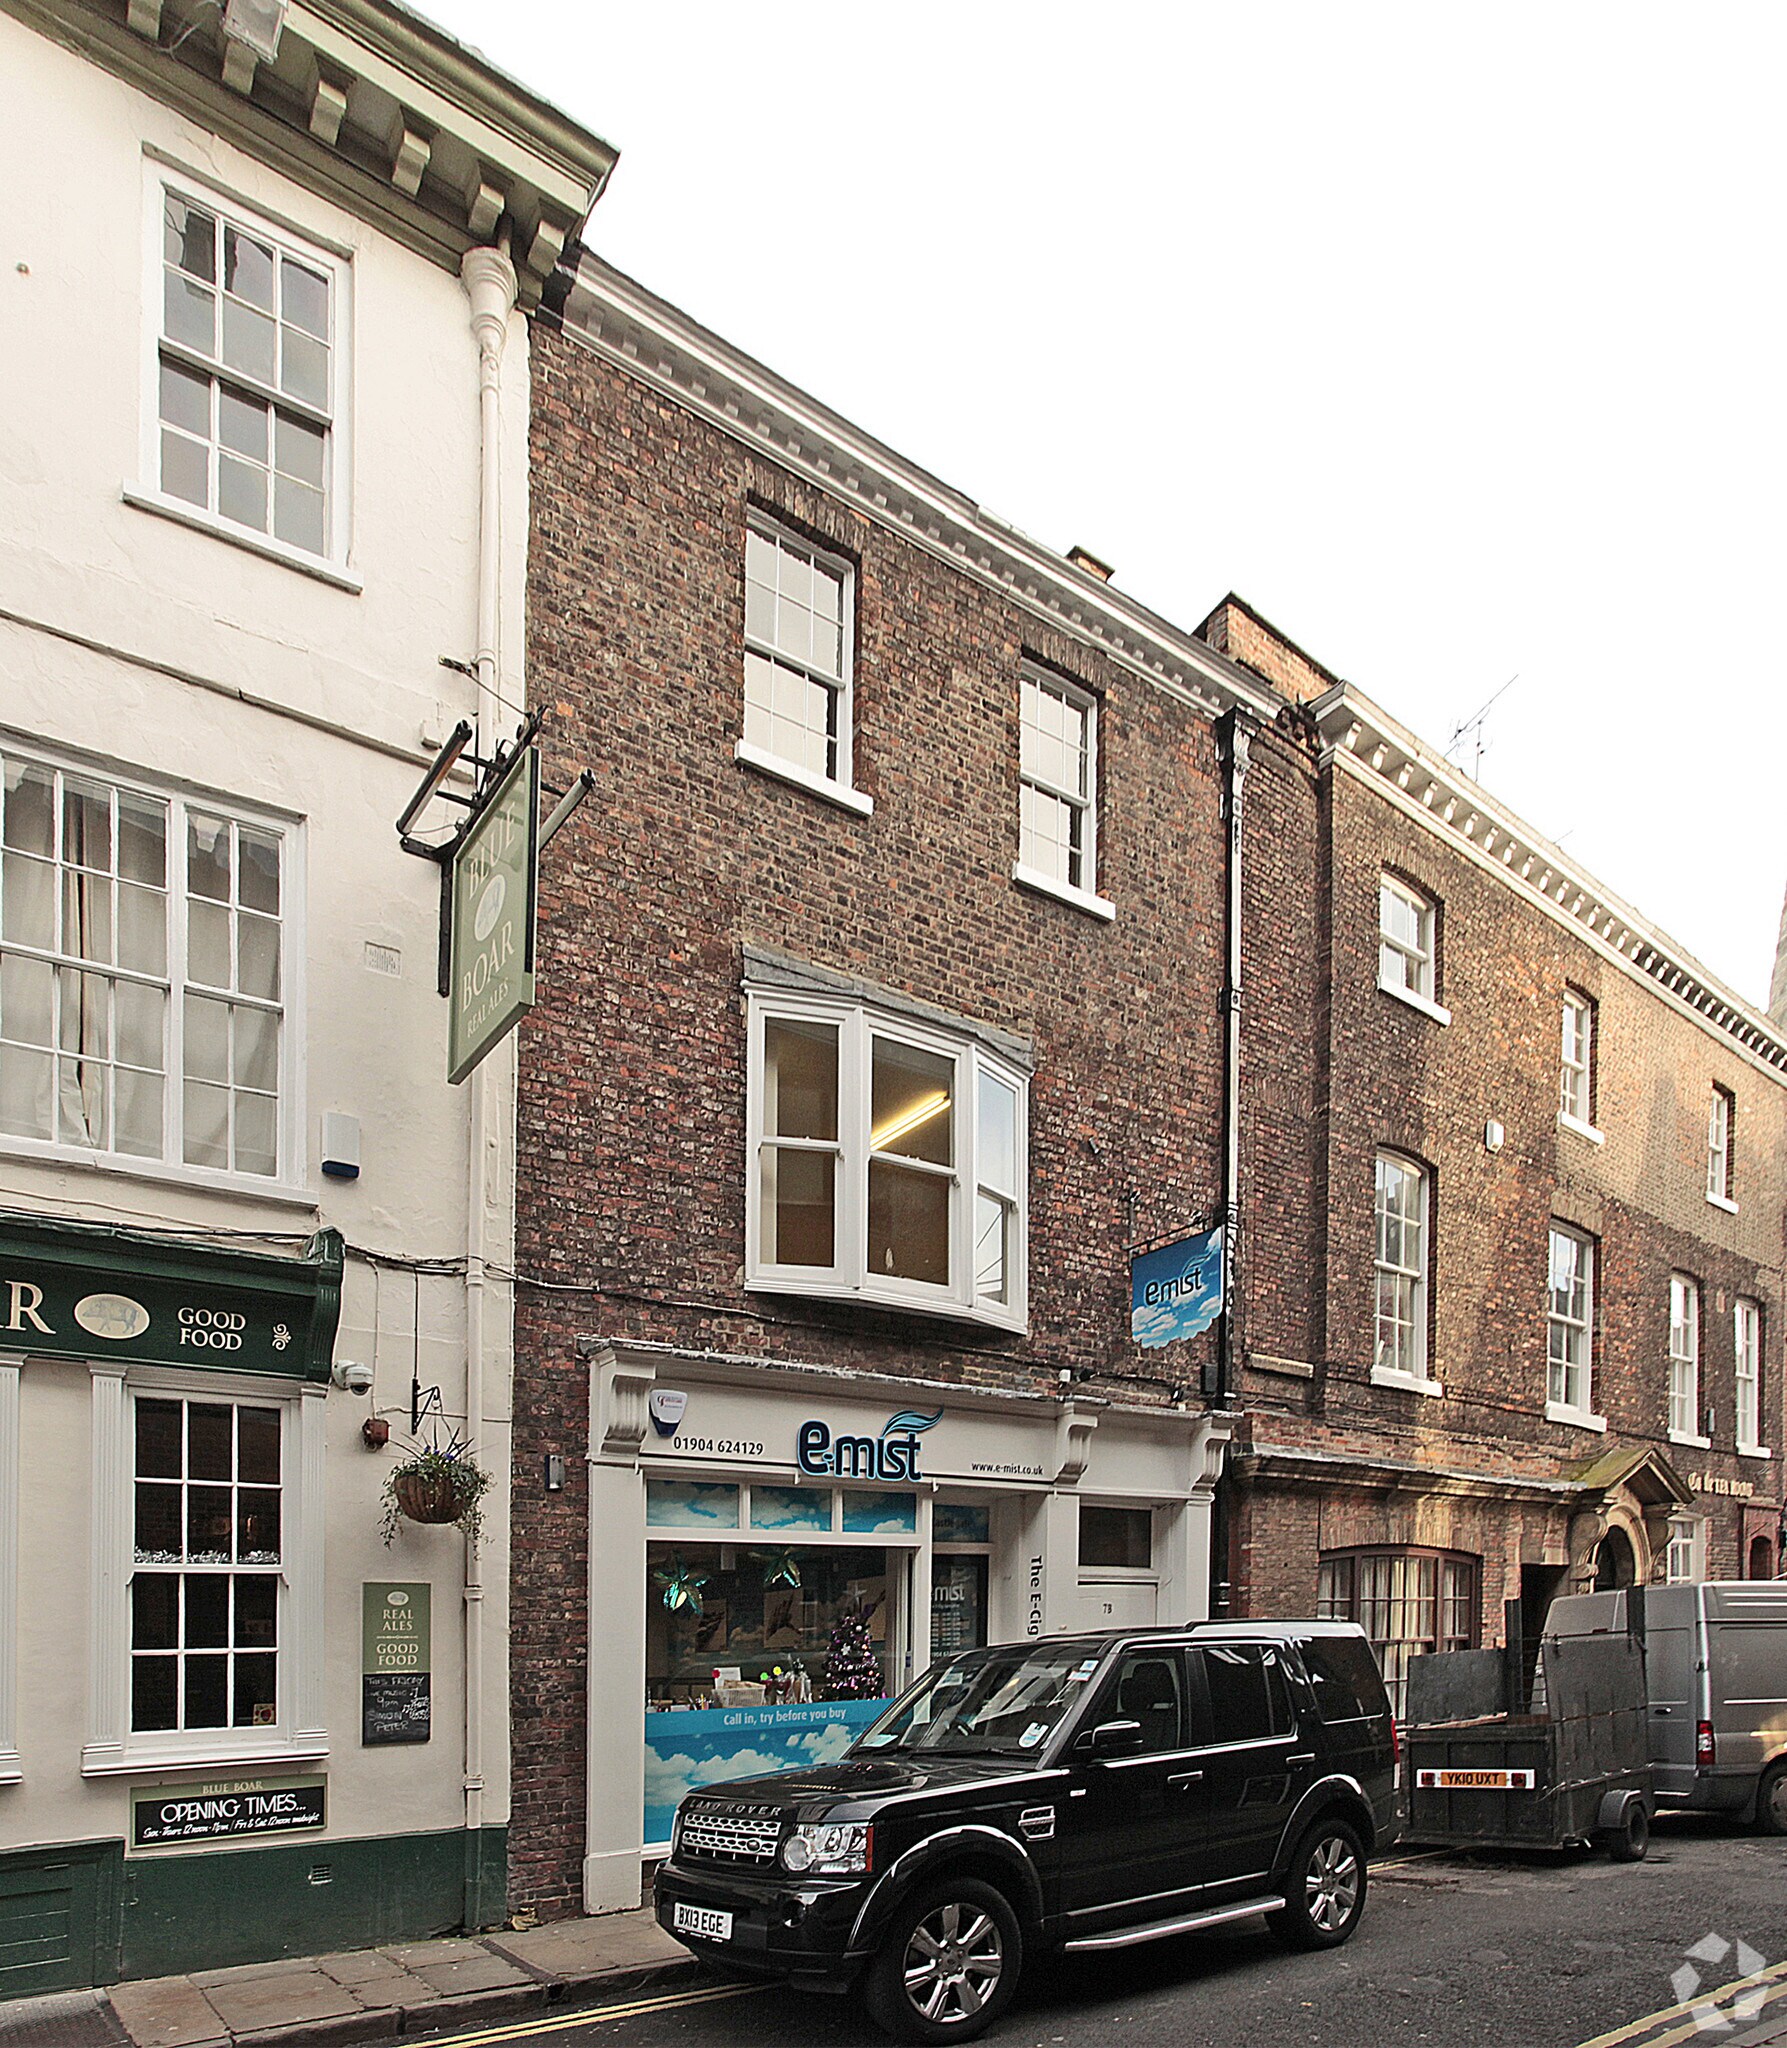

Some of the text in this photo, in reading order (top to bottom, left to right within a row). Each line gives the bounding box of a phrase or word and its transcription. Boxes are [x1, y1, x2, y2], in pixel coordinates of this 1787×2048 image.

[469, 801, 516, 900] BLUE
[462, 920, 514, 1013] BOAR
[467, 982, 509, 1038] REAL ALES
[177, 1306, 246, 1332] GOOD
[179, 1328, 243, 1351] FOOD
[673, 1436, 764, 1455] 01904 624129
[971, 1463, 1043, 1476] www.e-mist.co.uk
[1027, 1555, 1043, 1636] The E-Cig
[383, 1609, 414, 1620] REAL
[382, 1621, 413, 1631] ALES
[376, 1643, 419, 1655] GOOD
[378, 1654, 417, 1666] FOOD
[723, 1707, 847, 1726] Call in, try before you buy
[202, 1781, 263, 1794] BLUE BOAR
[1447, 1773, 1499, 1785] YK10 UXT
[160, 1800, 241, 1824] OPENING
[689, 1799, 782, 1816] LAND ROVER
[678, 1906, 724, 1934] BX13 EGE
